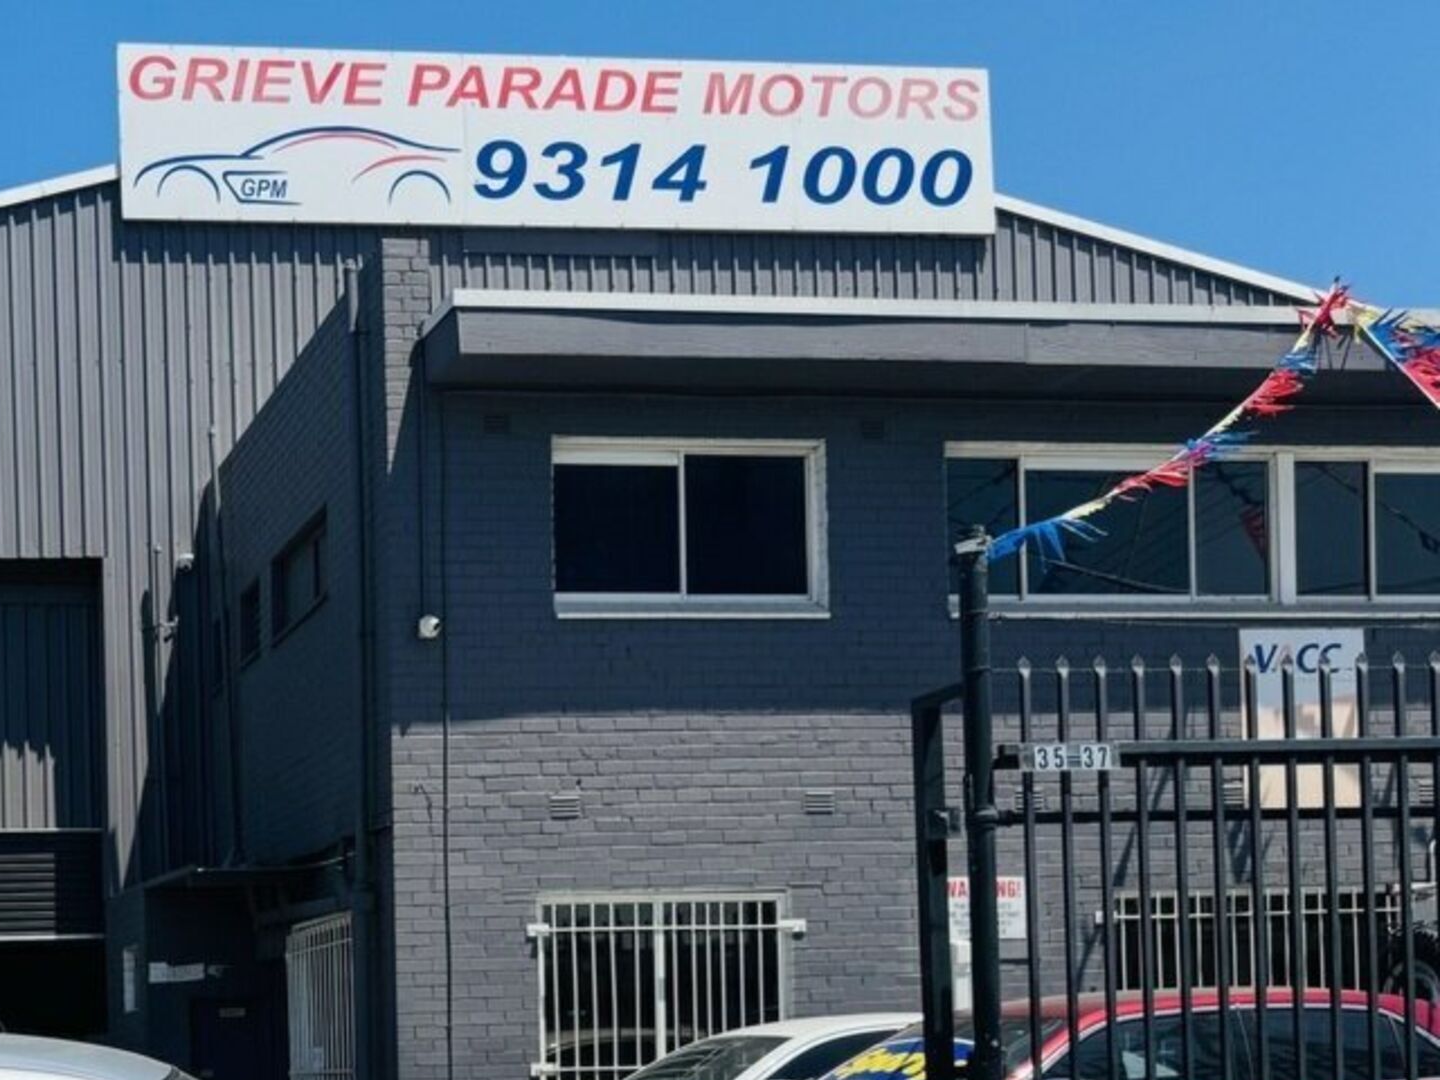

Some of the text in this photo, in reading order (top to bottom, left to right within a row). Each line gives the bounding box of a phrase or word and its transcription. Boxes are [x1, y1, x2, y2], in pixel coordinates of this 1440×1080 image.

[129, 56, 980, 122] GRIEVE PARADE MOTORS
[241, 178, 287, 198] GPM
[474, 139, 973, 207] 9314 1000
